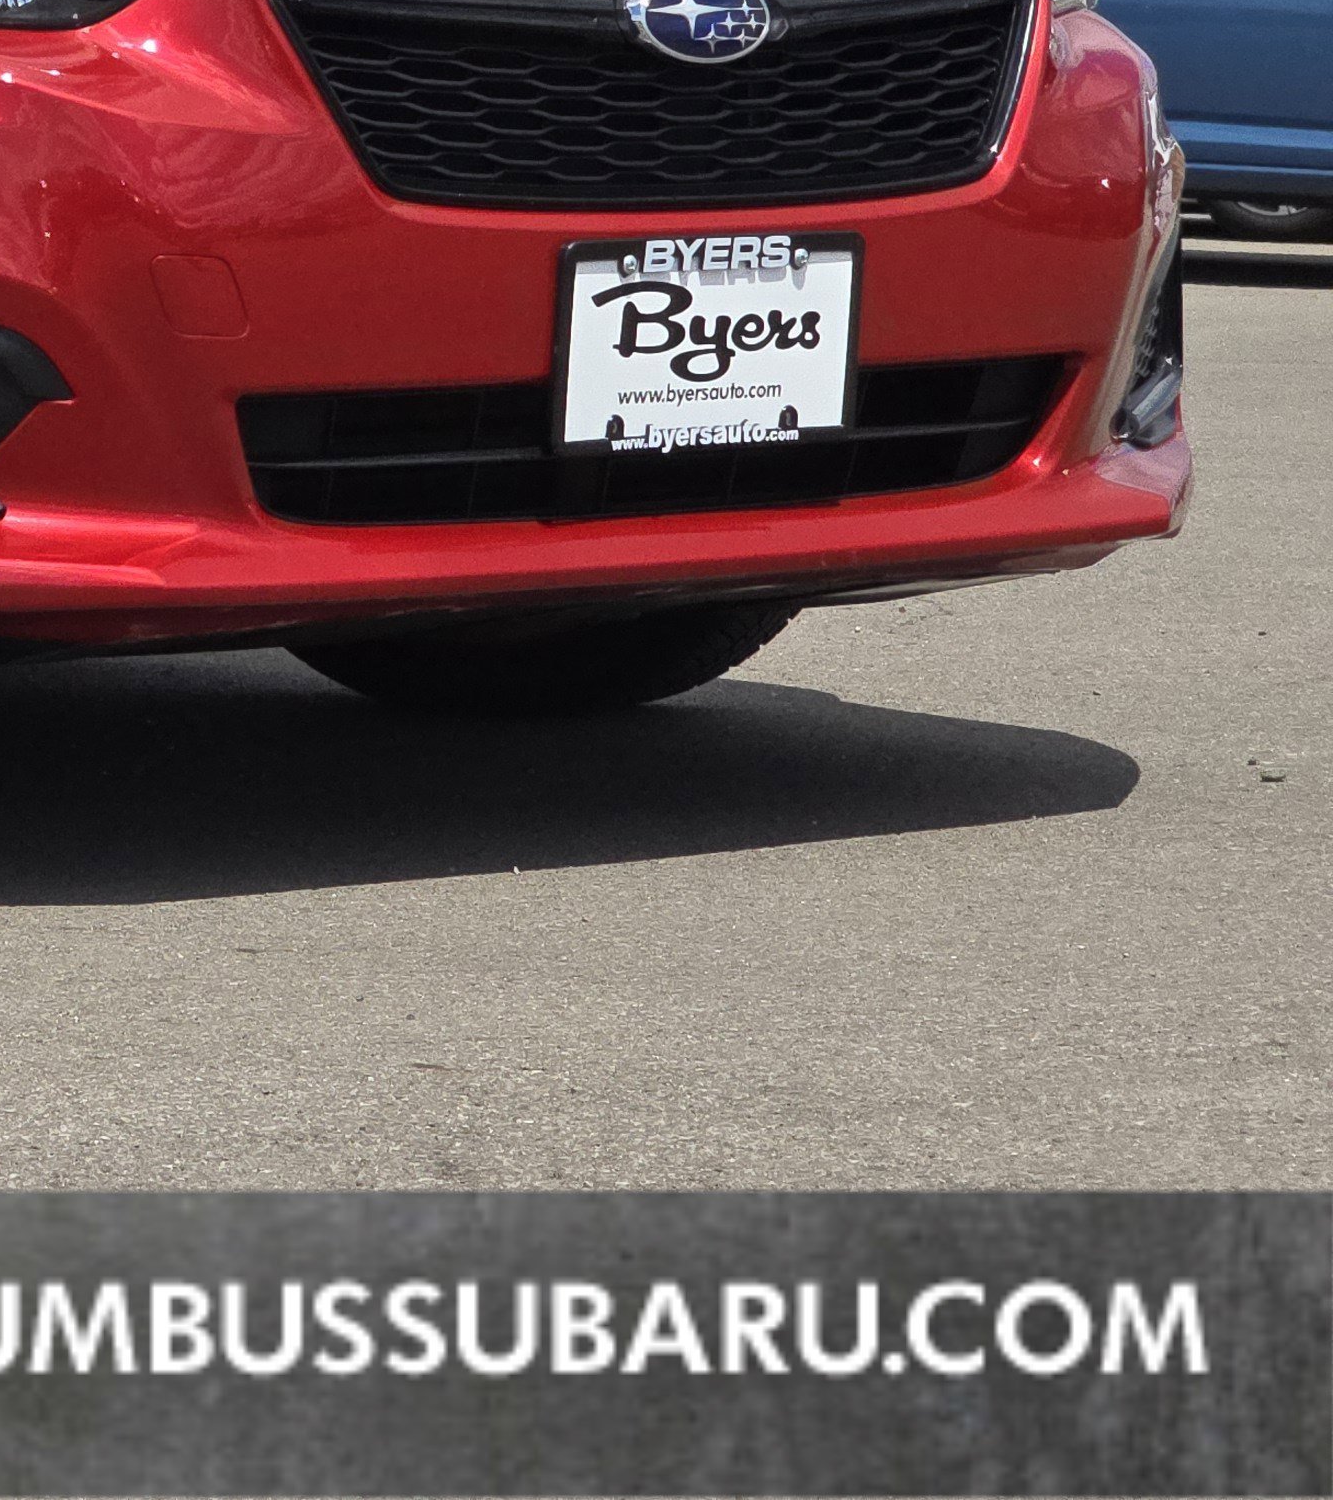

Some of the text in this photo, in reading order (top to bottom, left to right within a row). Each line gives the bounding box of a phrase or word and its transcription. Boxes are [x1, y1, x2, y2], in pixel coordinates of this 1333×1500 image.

[642, 236, 791, 274] BYERS
[590, 280, 821, 382] Byers
[617, 383, 782, 408] www.byersauto.com
[611, 419, 799, 453] www.byersauto.com
